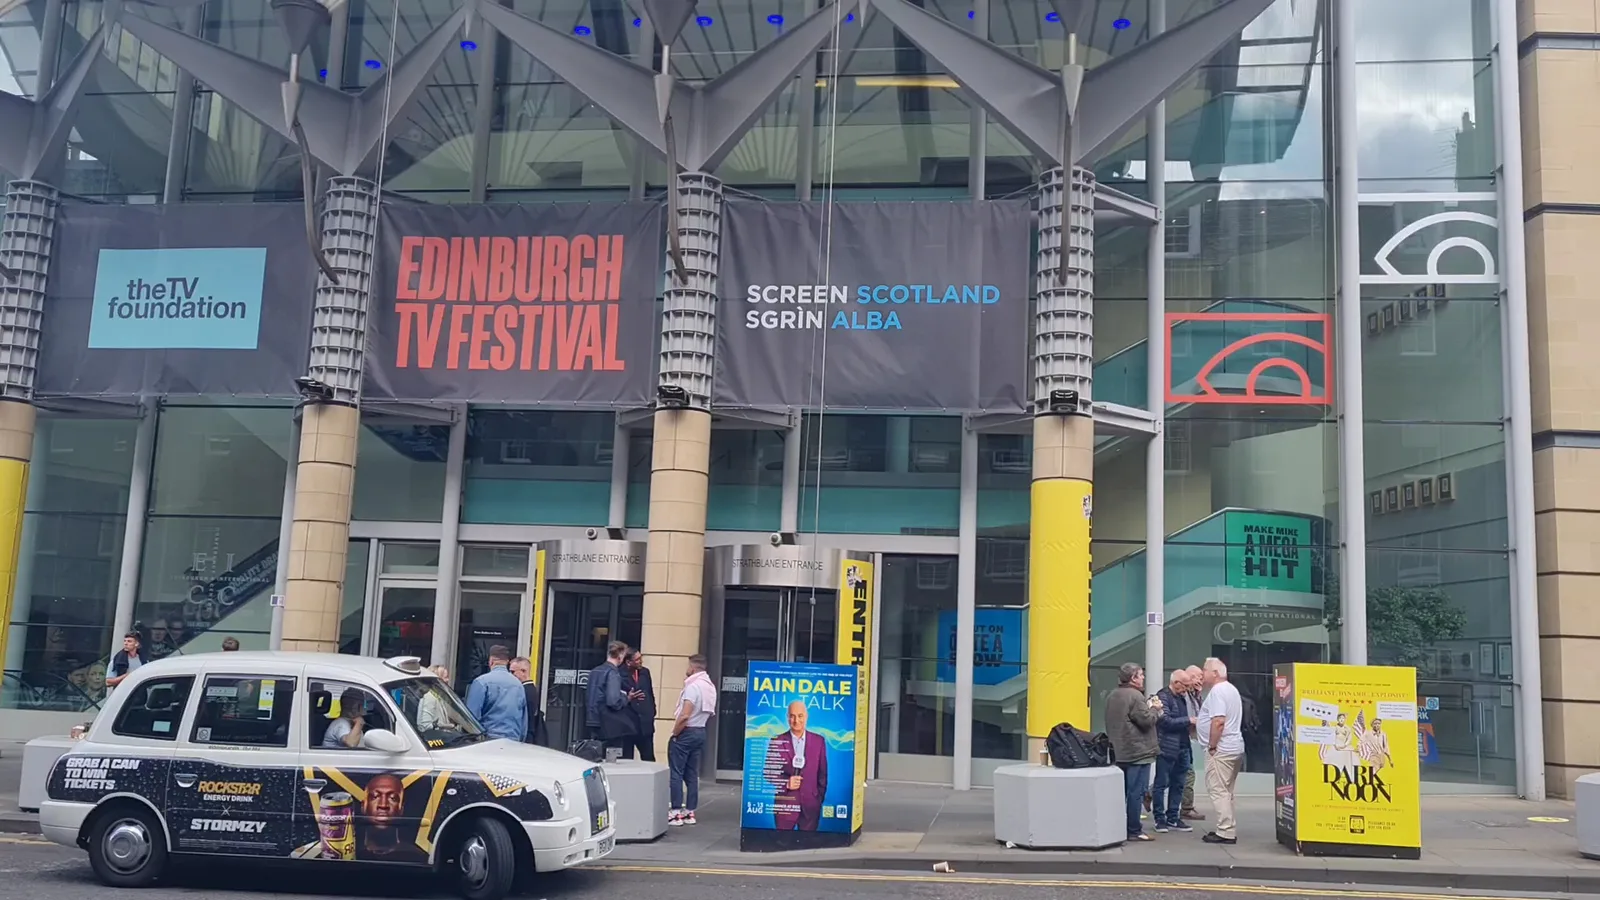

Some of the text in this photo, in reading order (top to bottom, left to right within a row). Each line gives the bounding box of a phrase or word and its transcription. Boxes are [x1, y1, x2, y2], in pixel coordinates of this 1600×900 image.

[396, 234, 624, 302] EDINBURGH
[747, 285, 1000, 304] SCREEN SCOTLAND
[108, 296, 246, 319] foundation
[745, 307, 902, 330] SGRÌN ALBA
[395, 303, 625, 370] TV FESTIVAL
[1244, 525, 1274, 534] MAKE
[1244, 534, 1299, 559] A MEGA
[552, 554, 640, 564] STRATHBLANE ENTRANCE
[732, 559, 823, 570] STRATHBLANE ENTRANCE
[1245, 557, 1299, 579] HIT
[753, 677, 796, 693] IAIN
[798, 680, 852, 696] DALE
[757, 693, 845, 711] ALL TALK
[66, 758, 140, 770] GRAB A CAN
[66, 768, 108, 779] TO WIN
[1323, 764, 1387, 786] DARK
[64, 779, 116, 790] TICKETS
[198, 781, 262, 795] ROCKSTAR
[1329, 783, 1392, 803] NOON
[231, 795, 254, 803] DRINK
[190, 819, 267, 833] STORMZY
